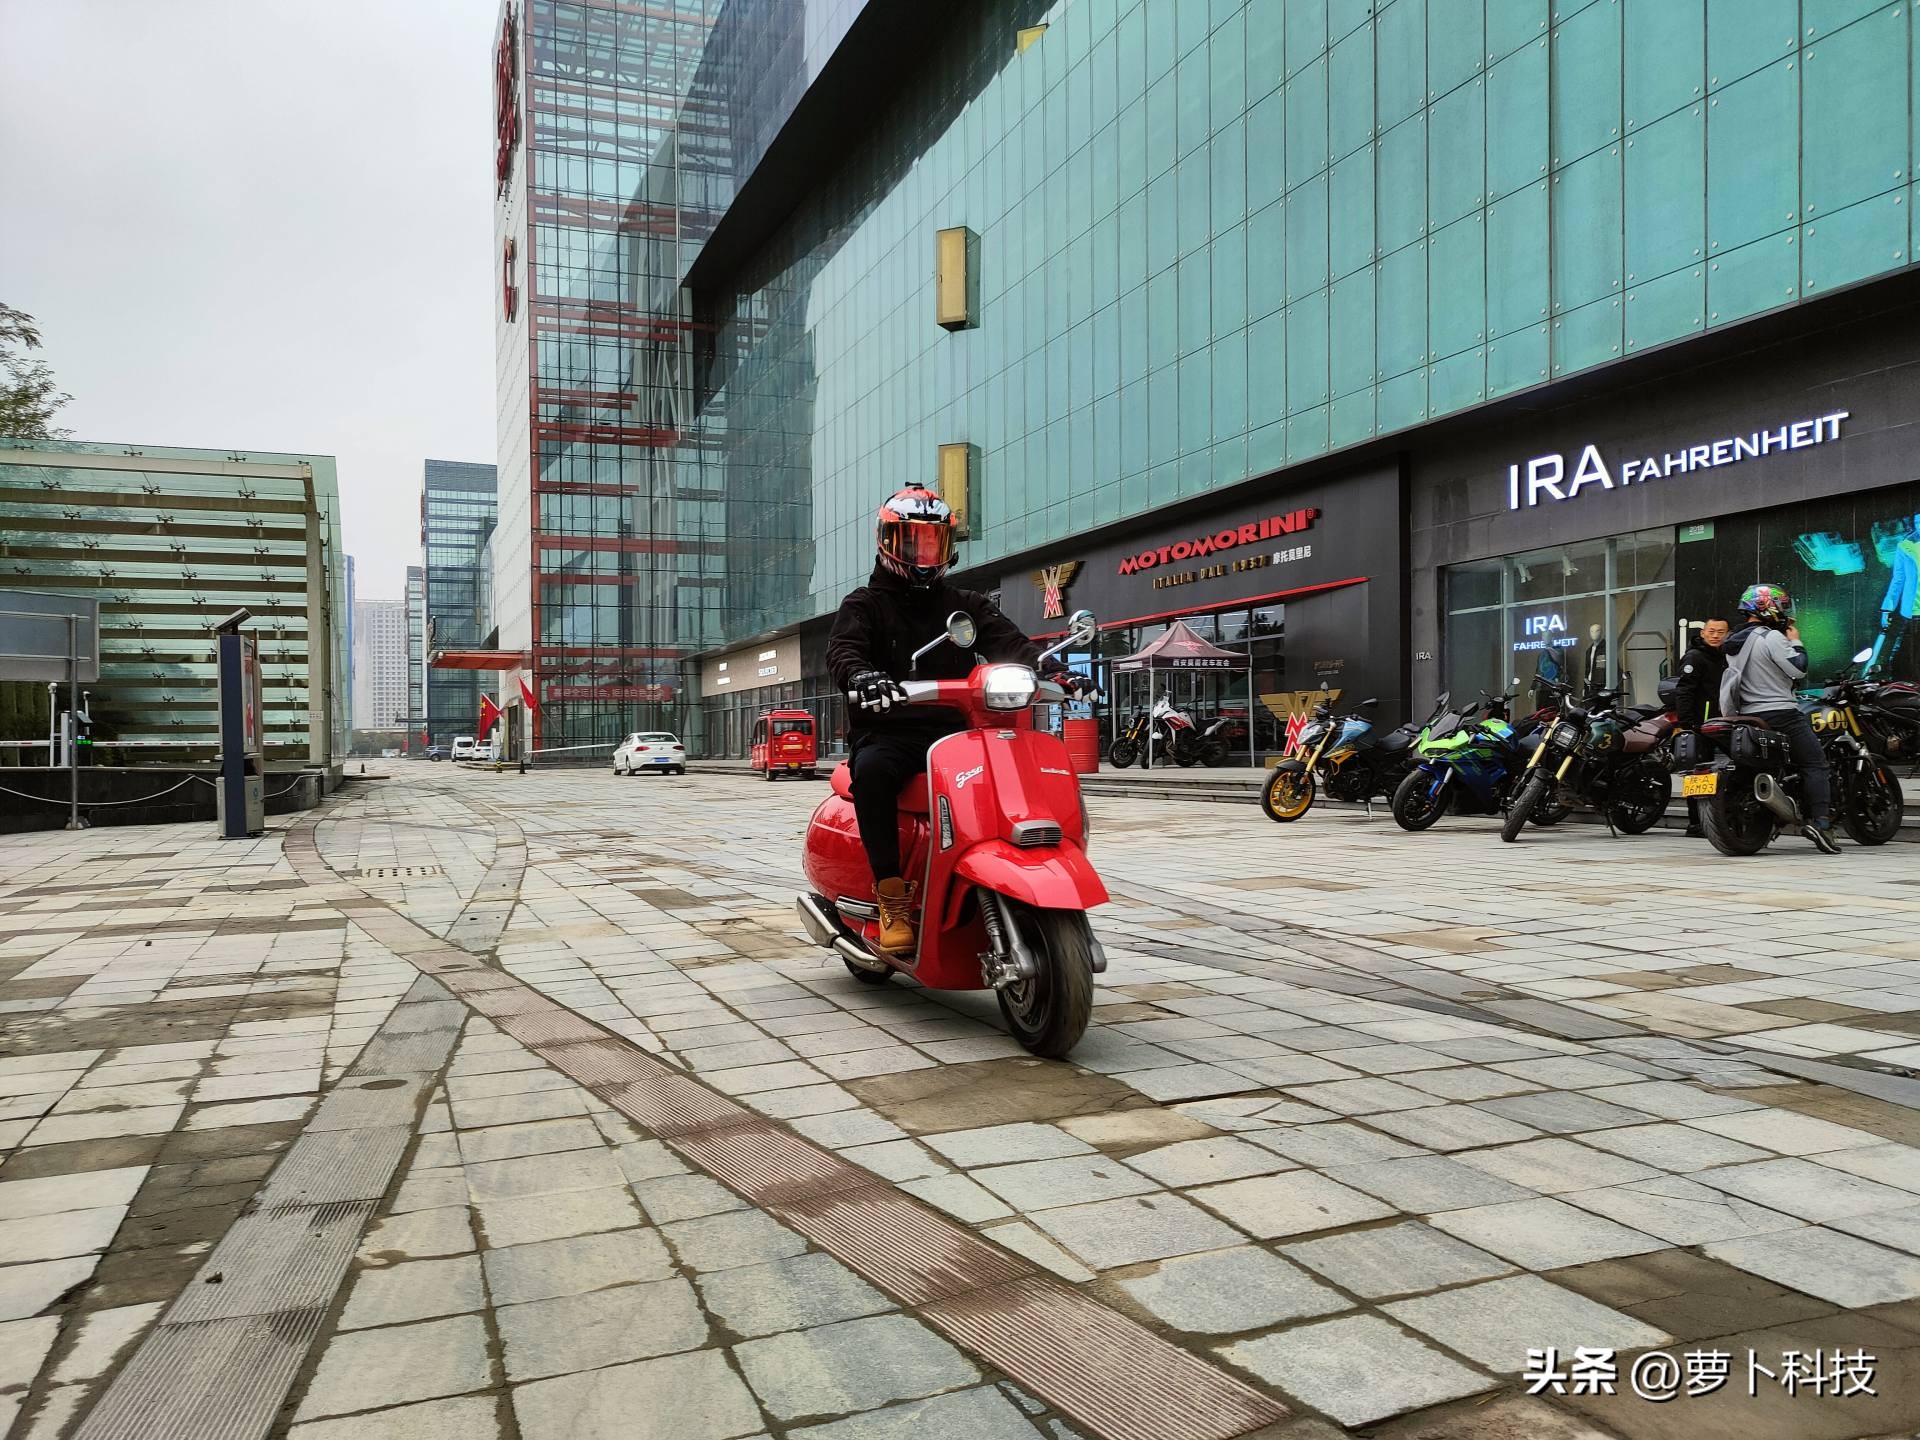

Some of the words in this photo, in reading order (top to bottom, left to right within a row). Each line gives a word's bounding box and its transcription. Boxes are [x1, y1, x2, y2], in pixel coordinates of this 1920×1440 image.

[1509, 444, 1615, 510] IRA
[1621, 411, 1850, 486] FAHRENHEIT
[1272, 545, 1312, 564] 摩托莫里尼
[1152, 571, 1193, 589] ITALIA
[1200, 565, 1222, 580] DAL
[1231, 555, 1264, 573] 1937
[1525, 614, 1565, 635] IRA
[1513, 637, 1579, 651] FAHREHEIT
